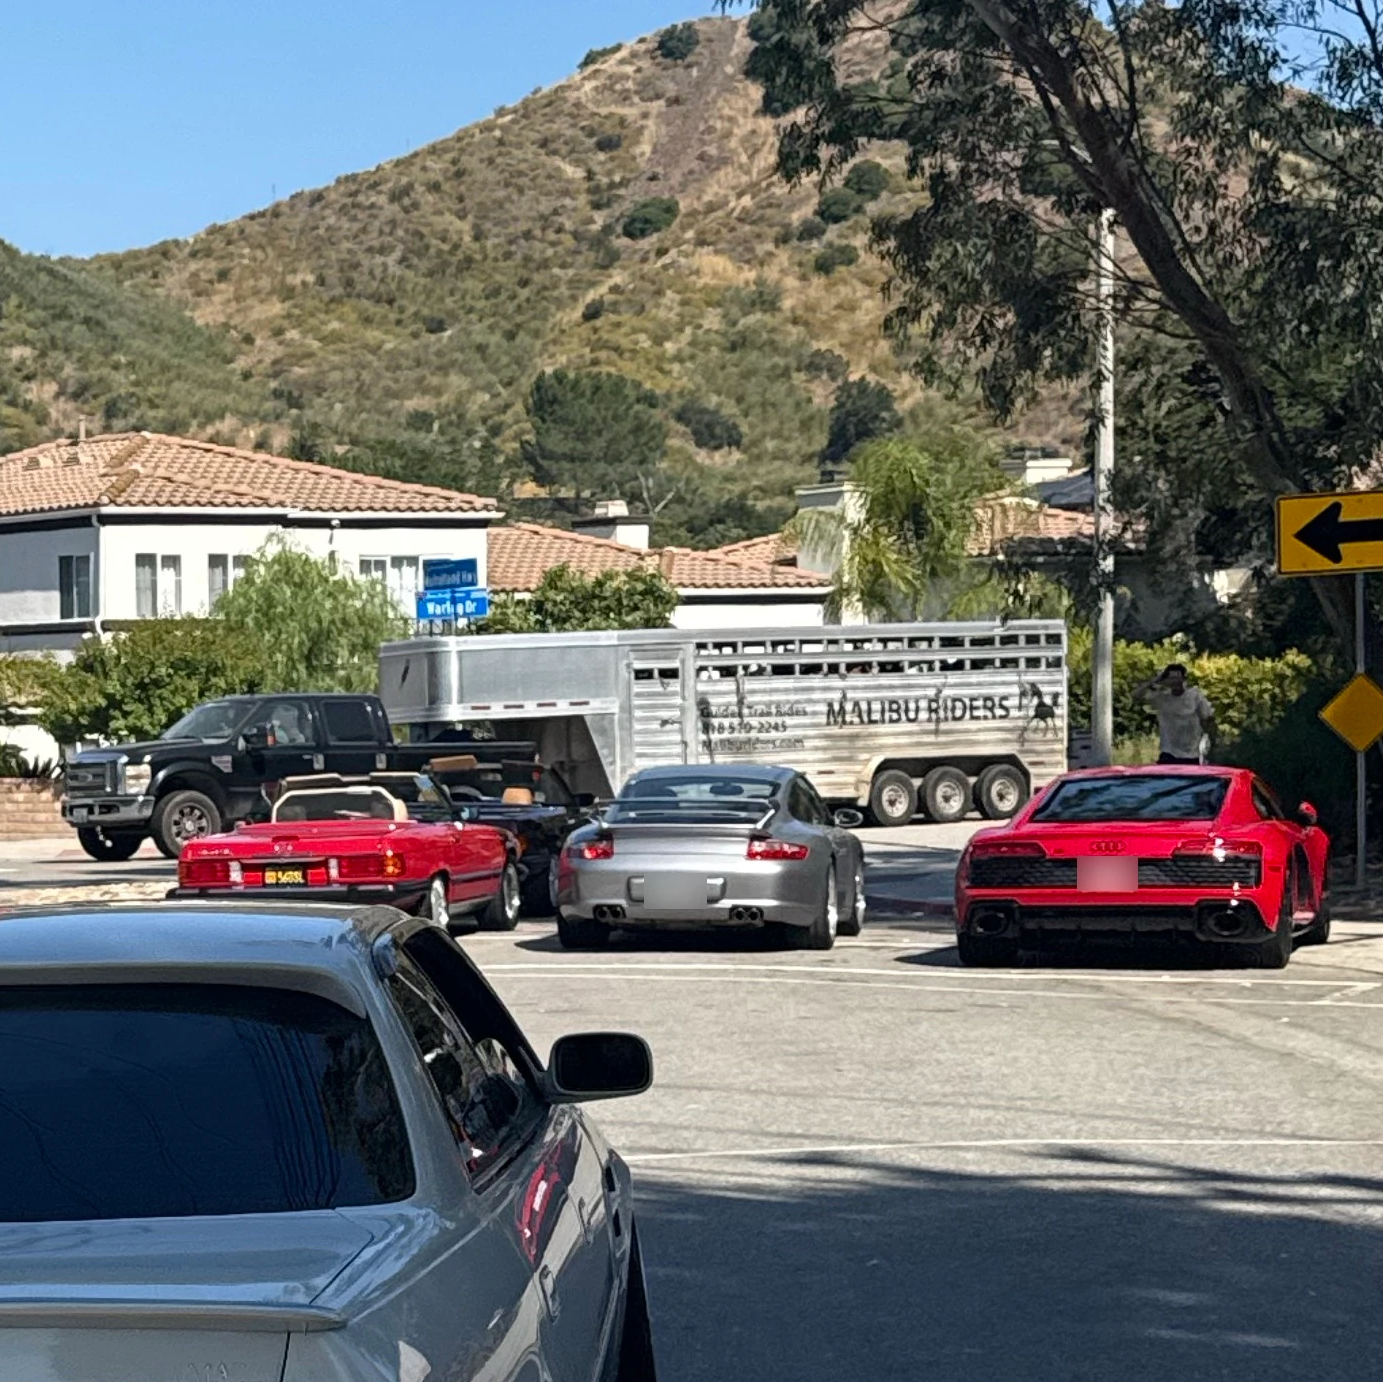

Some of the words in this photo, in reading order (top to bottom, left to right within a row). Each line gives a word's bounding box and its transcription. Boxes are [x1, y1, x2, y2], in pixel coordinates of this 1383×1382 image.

[465, 600, 478, 614] Dr
[826, 698, 919, 726] MALIBU
[926, 695, 1011, 723] RIDERS
